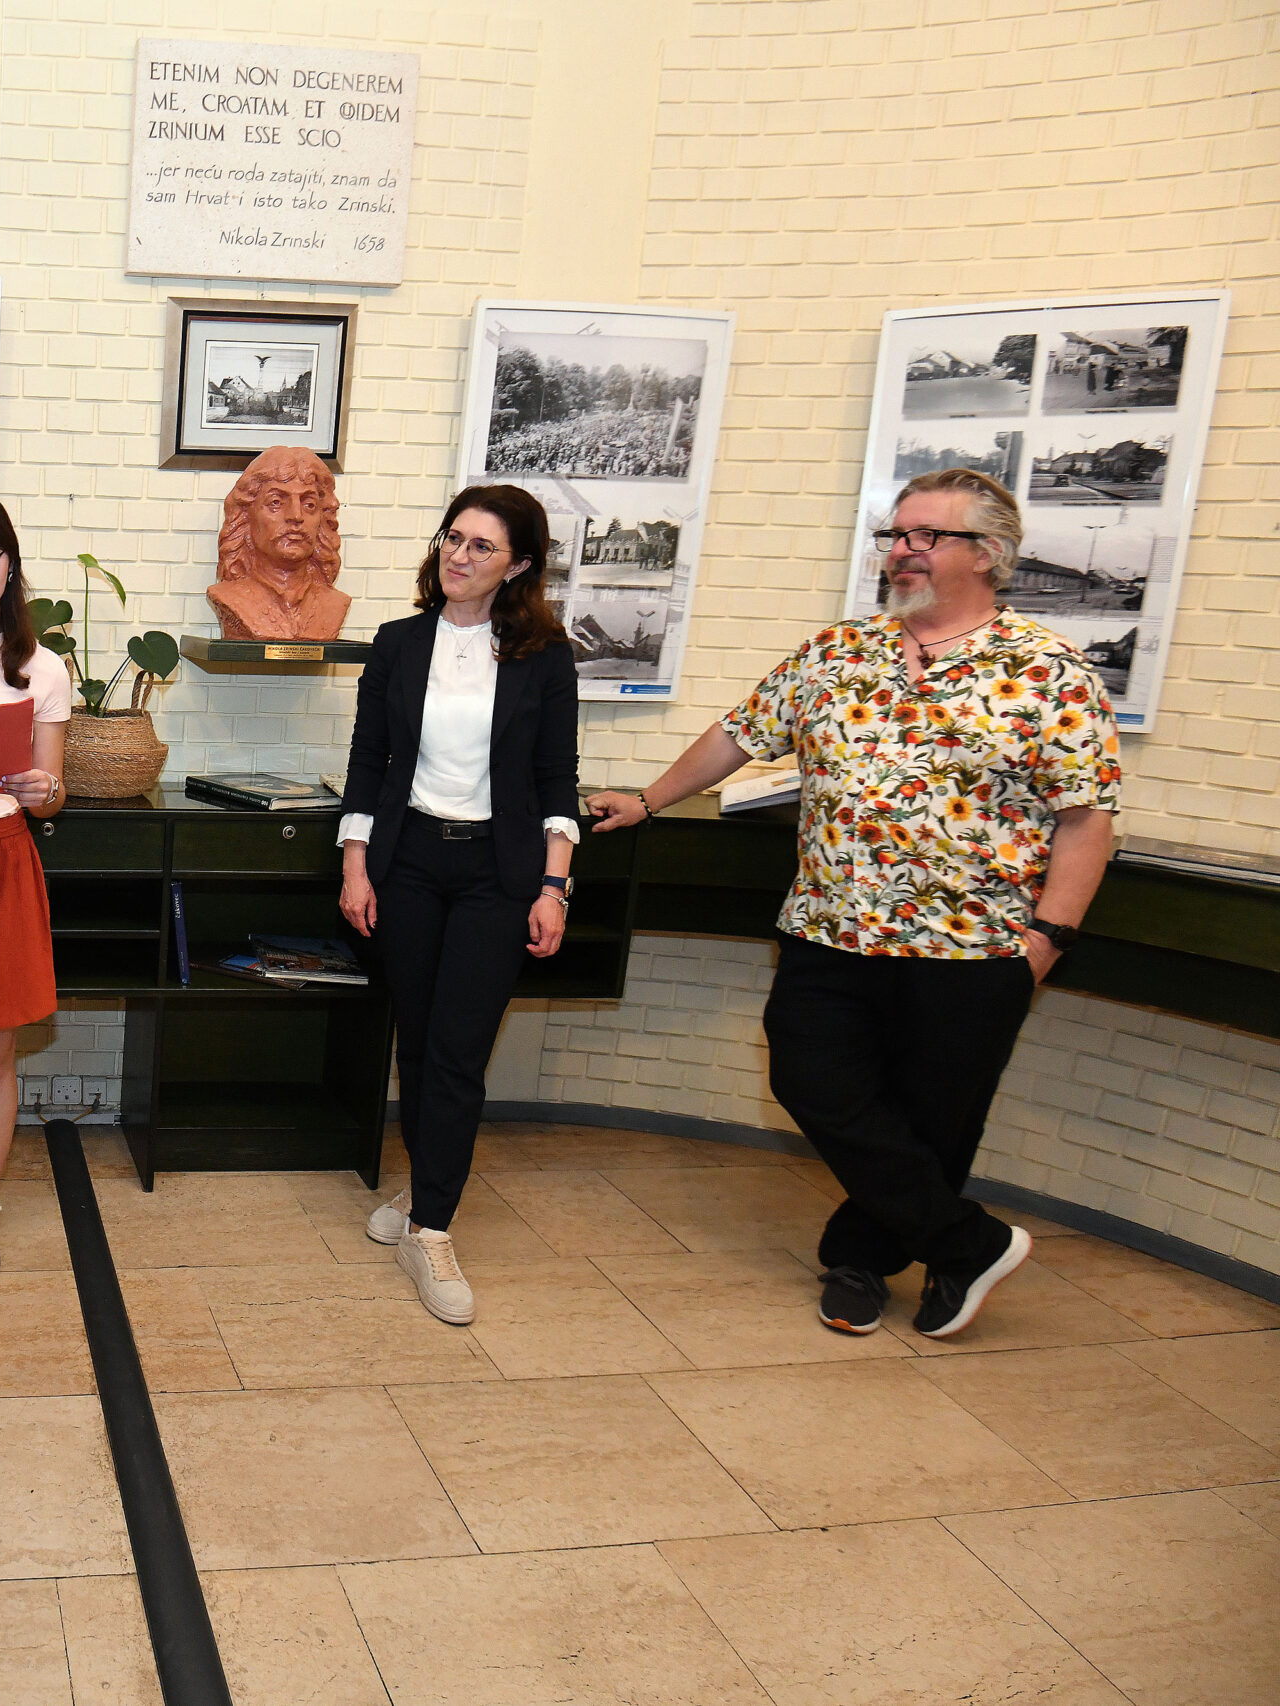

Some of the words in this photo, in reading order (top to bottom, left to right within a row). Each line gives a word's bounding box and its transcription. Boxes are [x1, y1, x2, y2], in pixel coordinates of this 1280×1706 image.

[150, 61, 220, 83] ETENIM
[235, 66, 279, 86] NON
[293, 70, 403, 95] DEGENEREM
[150, 92, 186, 114] ME,
[305, 100, 325, 118] ET
[148, 121, 225, 142] ZRINIUM
[244, 125, 281, 145] ESSE
[298, 128, 341, 148] SCIO
[185, 164, 222, 179] neću
[228, 162, 264, 182] roda
[270, 168, 326, 192] zatajiti,
[330, 175, 370, 187] znam
[377, 169, 397, 188] da
[145, 191, 176, 203] sam
[185, 190, 230, 206] Hrvat
[253, 192, 283, 208] isto
[292, 191, 328, 210] tako
[338, 195, 396, 214] Zrinski.
[219, 227, 268, 246] Nikola
[270, 230, 326, 249] Zrinski
[353, 237, 386, 253] 1658
